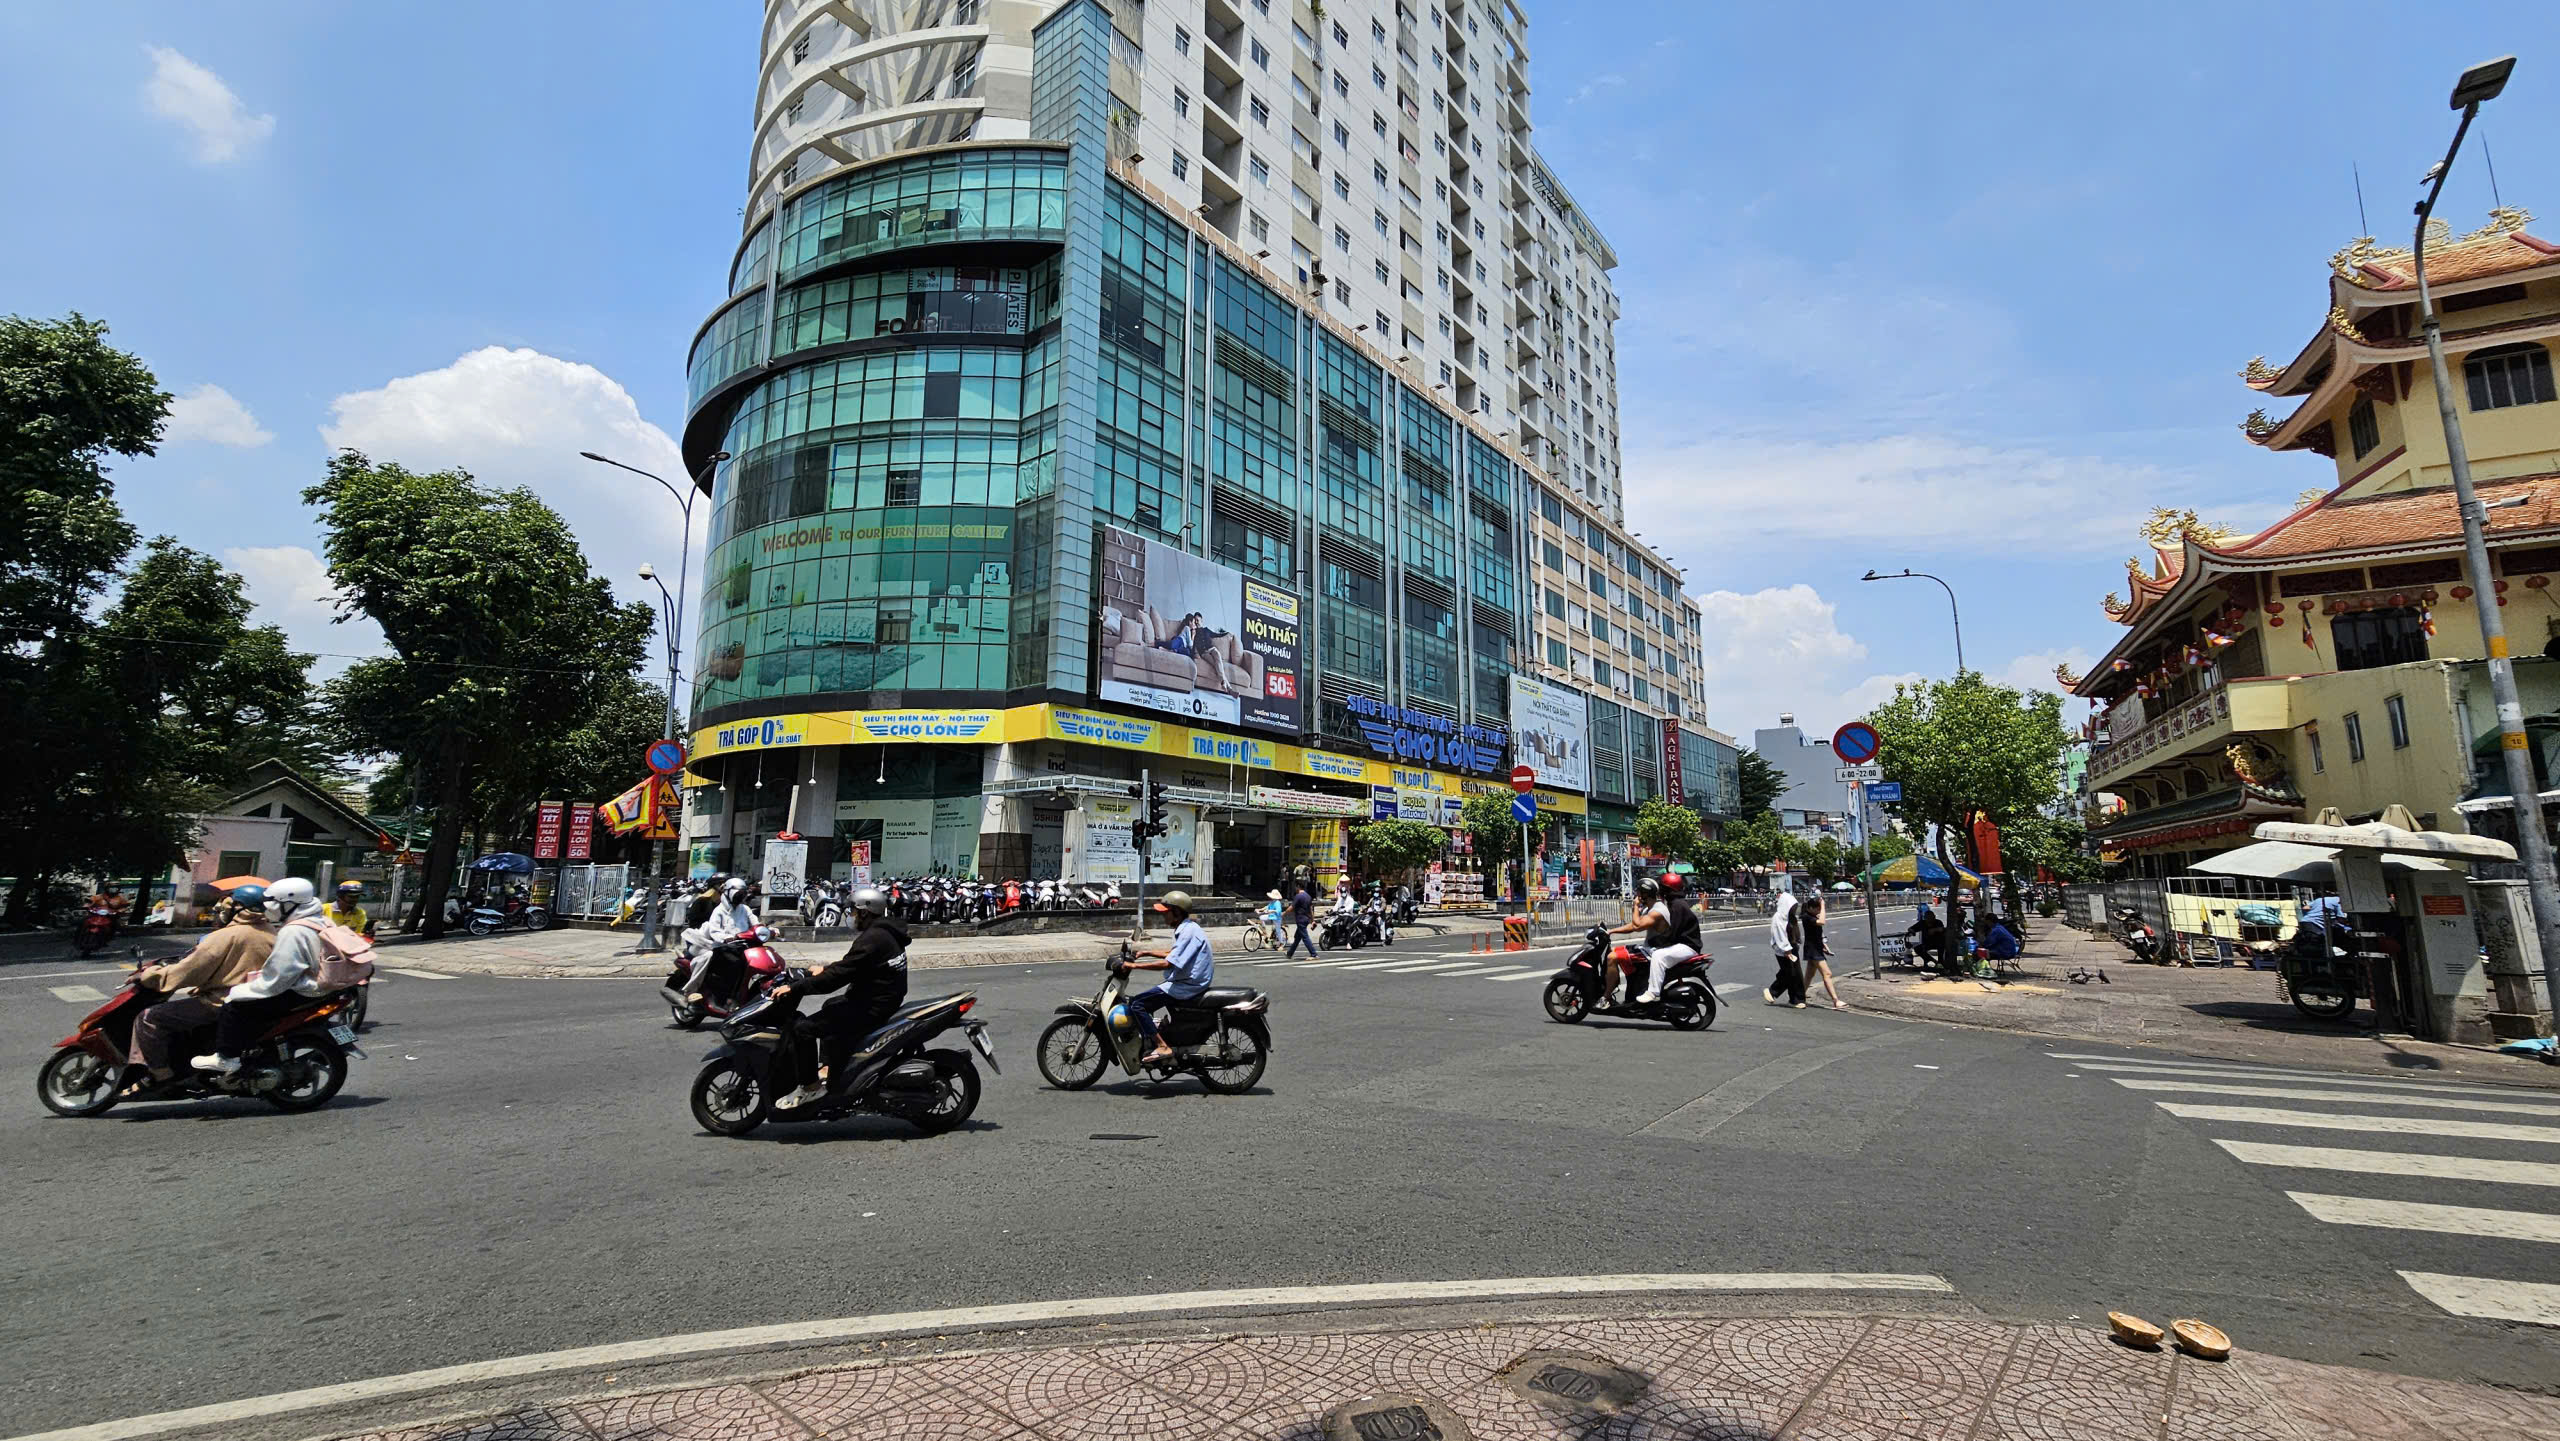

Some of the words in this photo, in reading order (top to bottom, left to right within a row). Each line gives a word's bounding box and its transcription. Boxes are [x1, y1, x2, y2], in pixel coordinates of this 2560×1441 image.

[1008, 271, 1021, 328] PILATES
[762, 526, 833, 553] WELCOME
[839, 529, 854, 541] TO
[857, 528, 880, 540] OUR
[885, 526, 948, 538] FURNITURE
[952, 524, 1008, 539] GALLERY
[1246, 618, 1267, 639] NỘI
[1268, 626, 1297, 646] THẤT
[1253, 641, 1272, 654] NHẬP
[890, 724, 922, 738] CHỢ
[1347, 695, 1376, 716] SIÊU
[1381, 702, 1399, 726] THỊ
[1401, 707, 1428, 731] ĐIỆN
[1430, 716, 1455, 734] MÁY
[1486, 725, 1510, 747] THẤT
[718, 725, 734, 748] TRẢ
[737, 722, 759, 744] GÓP
[1078, 724, 1104, 741] CHỢ
[1193, 735, 1213, 755] TRẢ
[1217, 739, 1238, 758] GÓP
[1394, 728, 1435, 769] CHỢ
[1439, 735, 1476, 769] LỚN
[1393, 768, 1406, 784] TRẢ
[1408, 771, 1421, 786] GÓP
[1667, 737, 1680, 803] AGRIBANK
[1181, 774, 1206, 788] Index
[543, 813, 558, 822] TẾT
[574, 815, 590, 824] TẾT
[1033, 814, 1064, 822] OSHIBA
